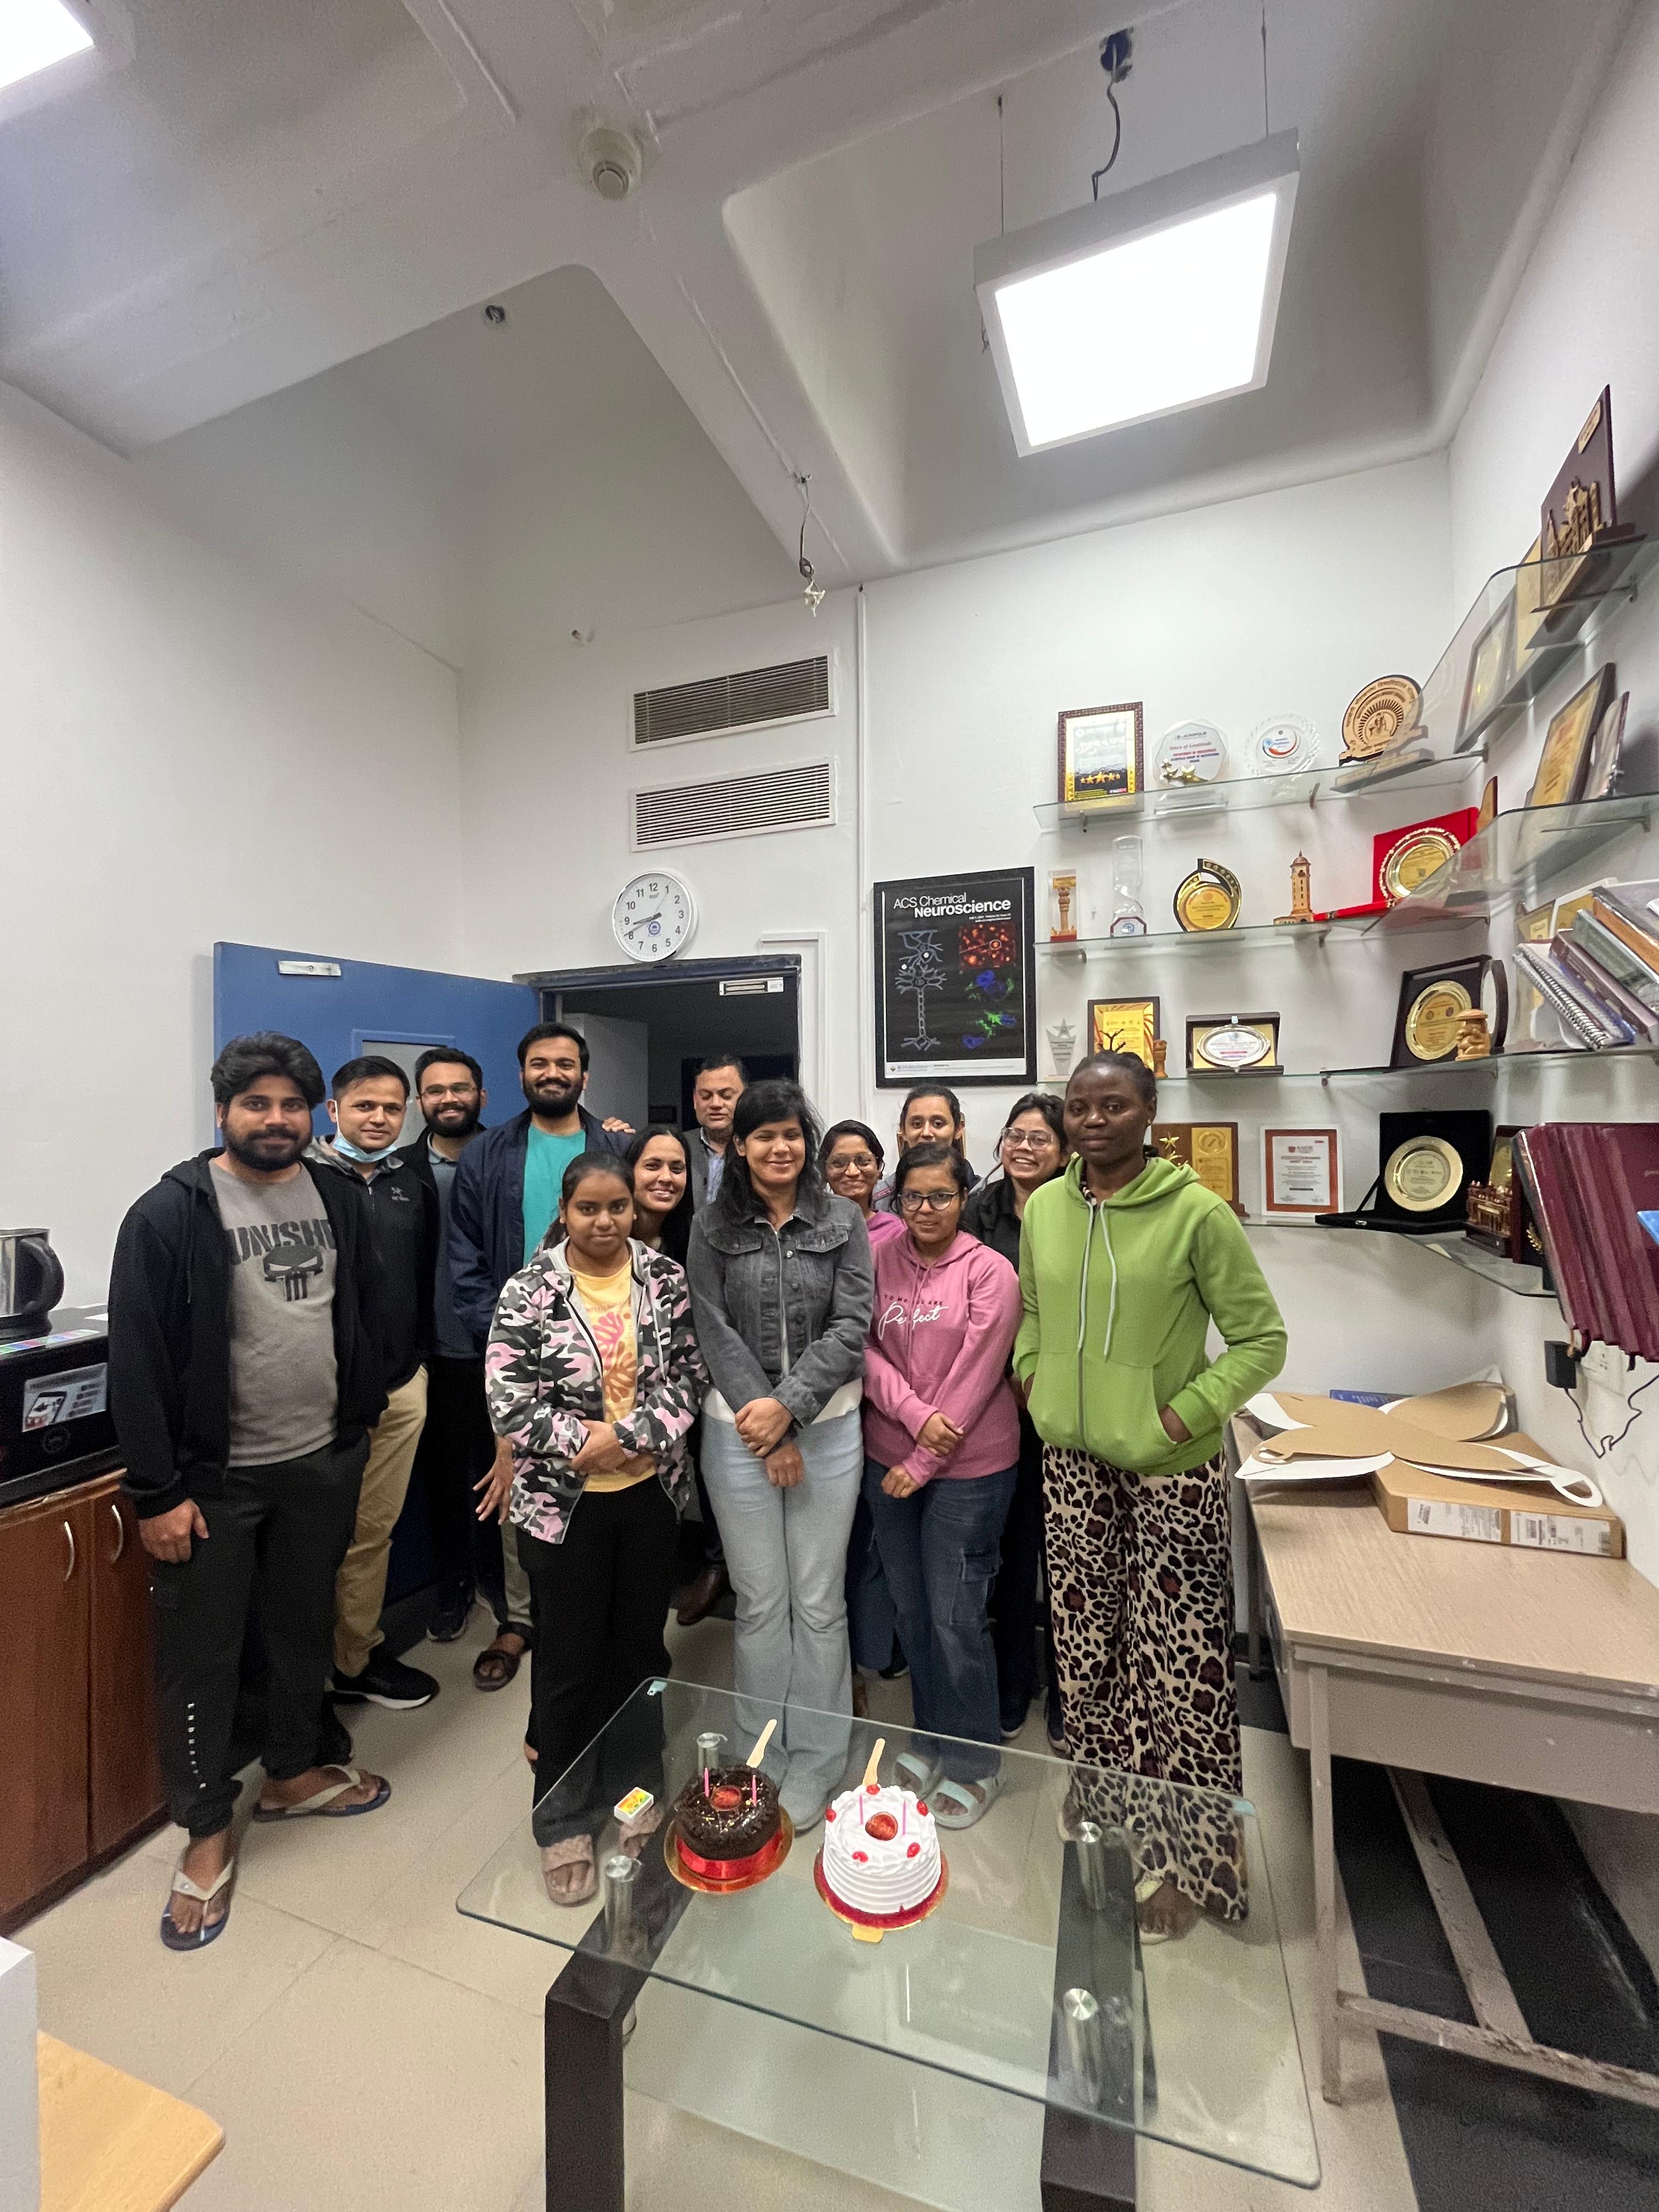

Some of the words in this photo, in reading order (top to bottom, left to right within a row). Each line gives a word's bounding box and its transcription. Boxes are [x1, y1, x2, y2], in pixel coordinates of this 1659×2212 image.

[648, 883, 658, 891] 12
[665, 885, 669, 894] 1
[636, 889, 644, 898] 11
[674, 895, 680, 904] 2
[893, 897, 917, 909] ACS
[919, 892, 967, 907] Chemical
[626, 901, 636, 910] 10
[914, 899, 1012, 918] Neuroscience
[679, 910, 684, 919] 3
[624, 916, 630, 925] 9
[675, 926, 681, 934] 4
[628, 930, 634, 940] 8
[638, 941, 644, 950] 7
[666, 939, 671, 947] 5
[652, 944, 657, 952] 6
